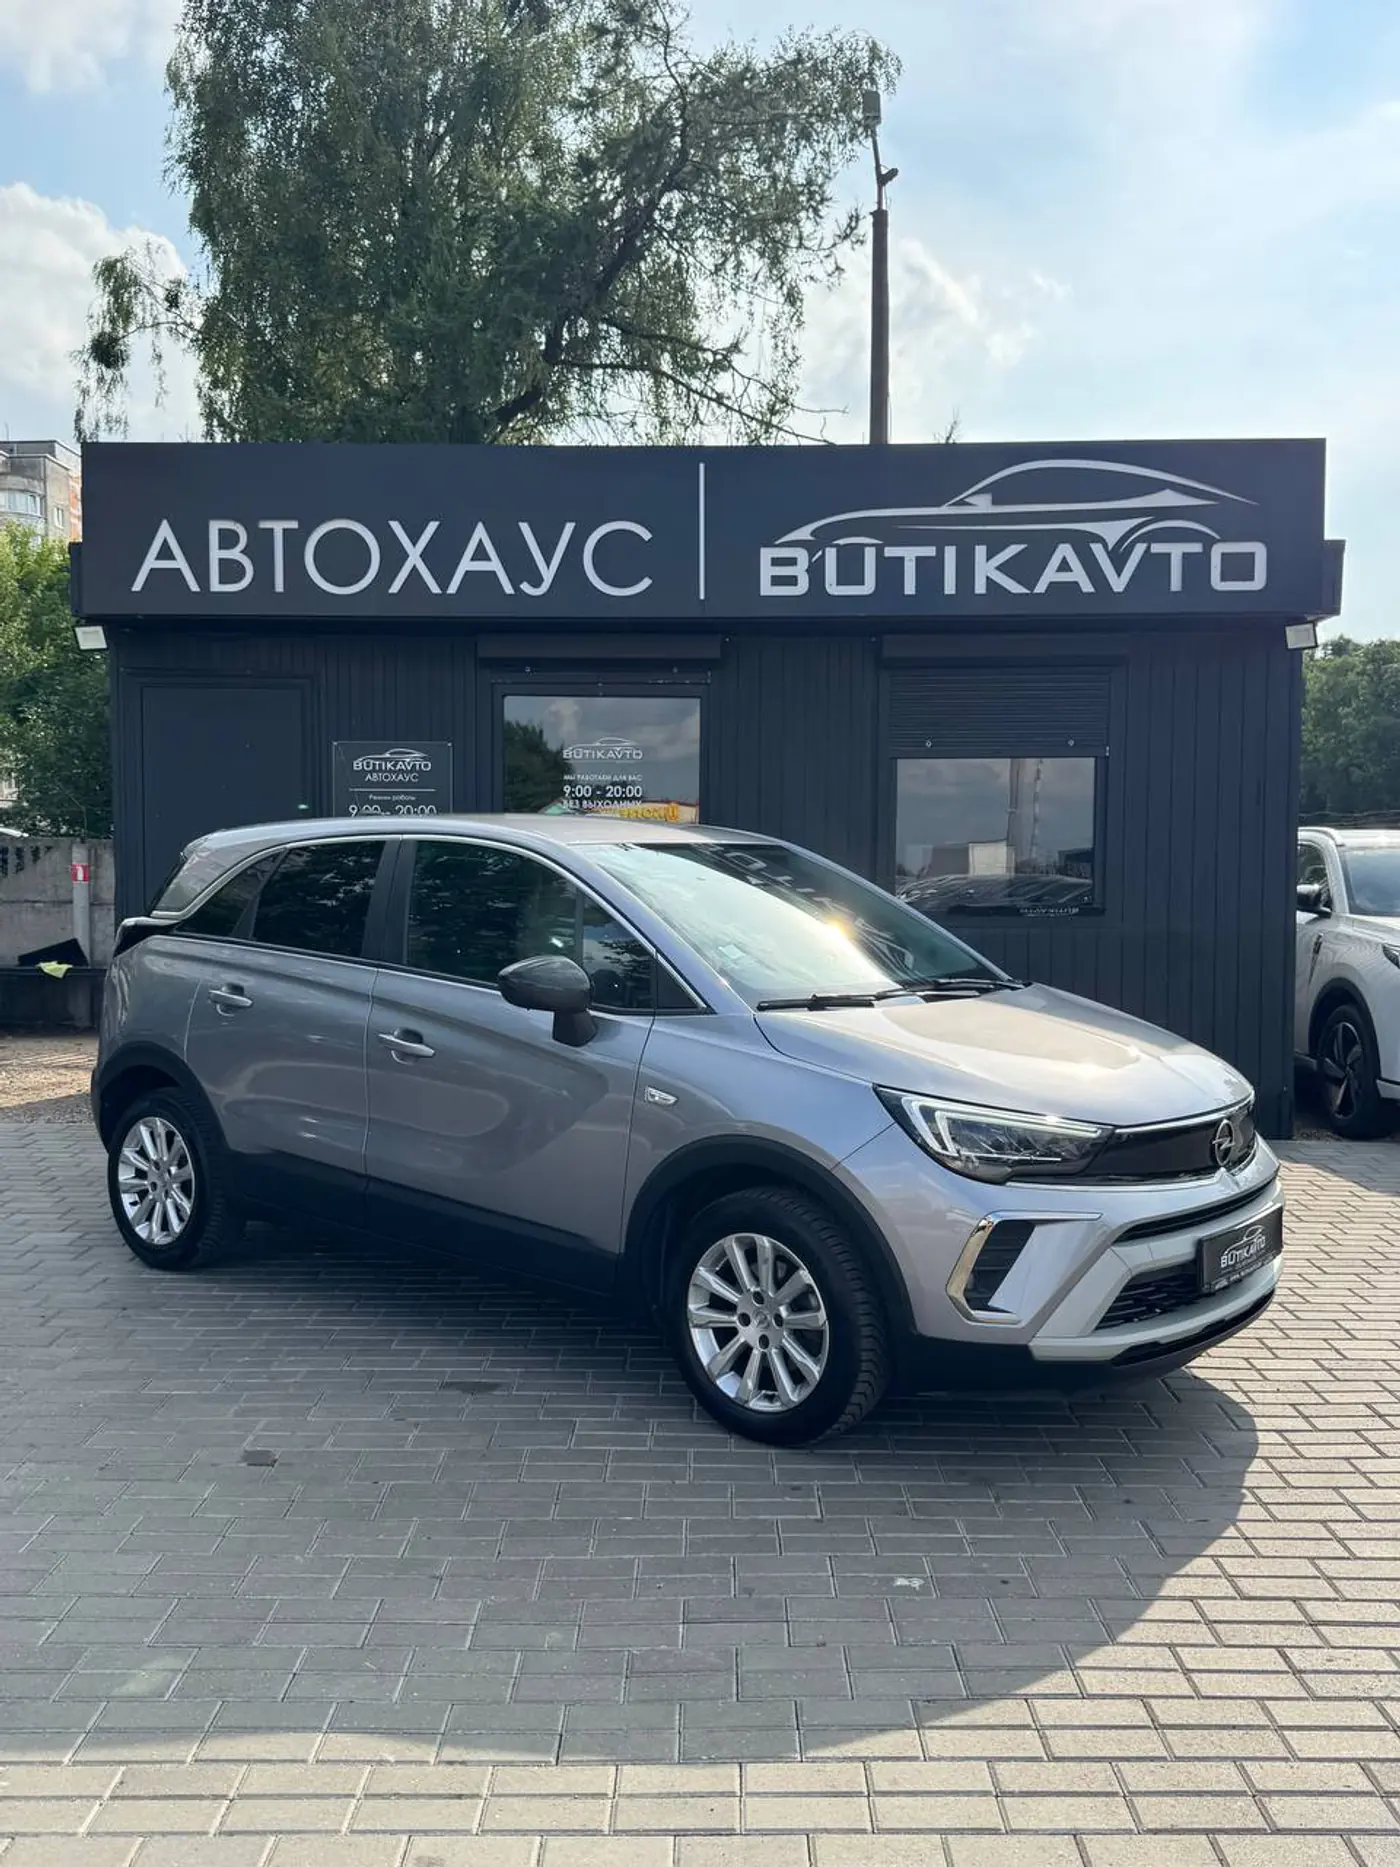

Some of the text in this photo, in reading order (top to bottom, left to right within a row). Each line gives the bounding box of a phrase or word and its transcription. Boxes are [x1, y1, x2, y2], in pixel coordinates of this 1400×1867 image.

[131, 519, 653, 597] АВТОХАУС
[759, 541, 1267, 597] BUTIKAVTO
[563, 749, 643, 759] BUTIKAVTO
[353, 761, 432, 771] BUTIKAVTO
[365, 773, 419, 782] АВТОХАУС
[563, 785, 592, 798] 9:00
[605, 785, 643, 798] 20:00
[348, 804, 381, 817] 900
